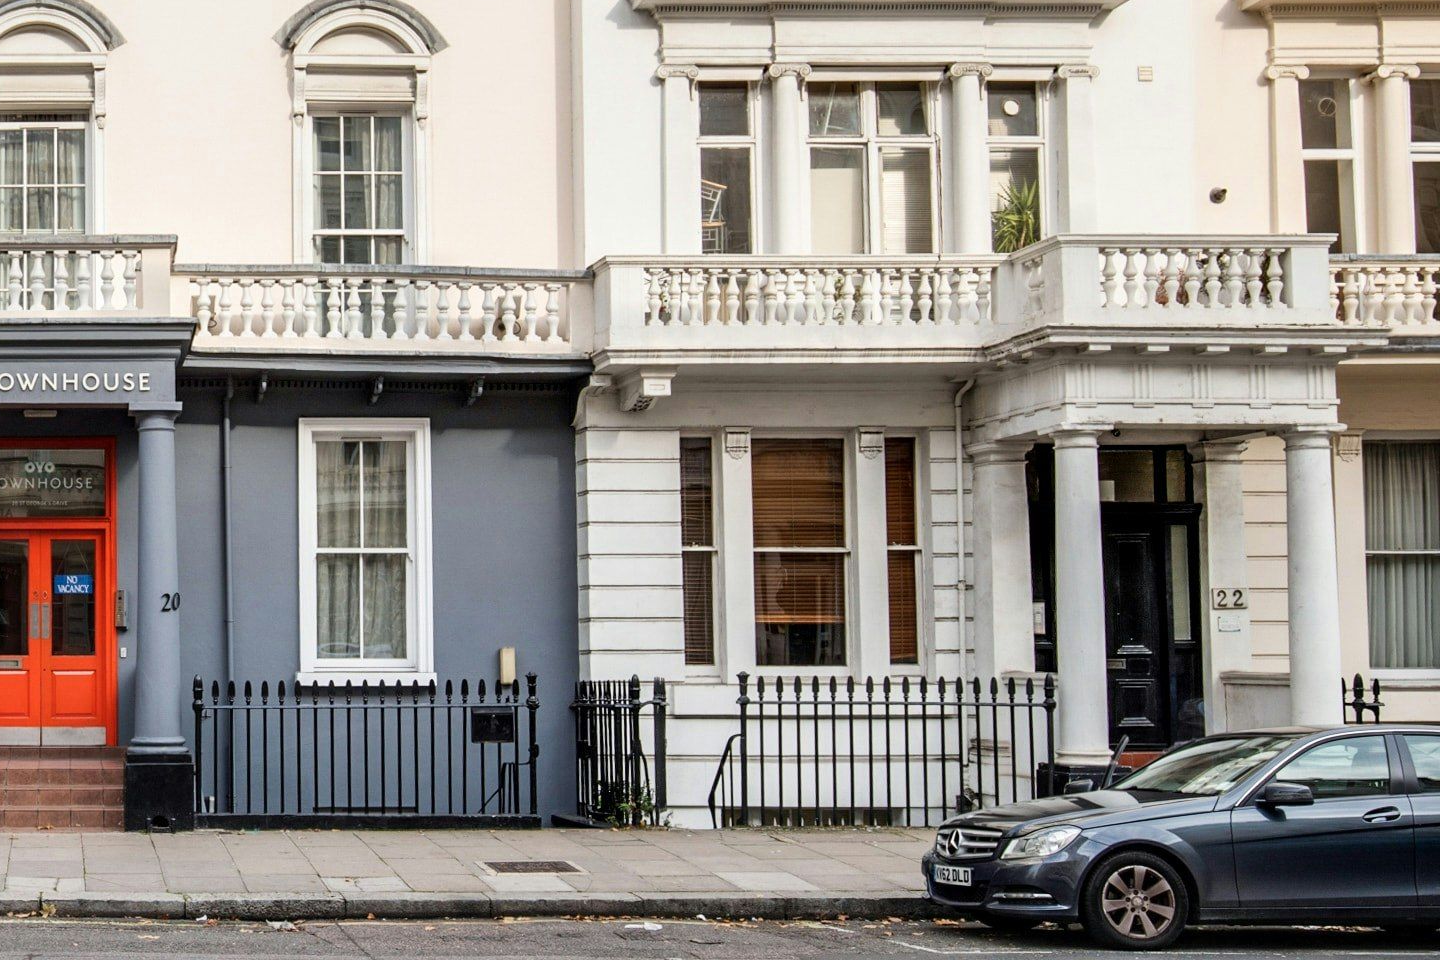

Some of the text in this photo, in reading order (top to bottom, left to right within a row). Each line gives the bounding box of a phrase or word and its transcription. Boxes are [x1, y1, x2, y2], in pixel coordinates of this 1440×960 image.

[24, 461, 56, 473] OYO
[66, 575, 78, 584] NO
[57, 584, 89, 593] VACANCY
[160, 592, 180, 613] 20
[1217, 589, 1244, 608] 22
